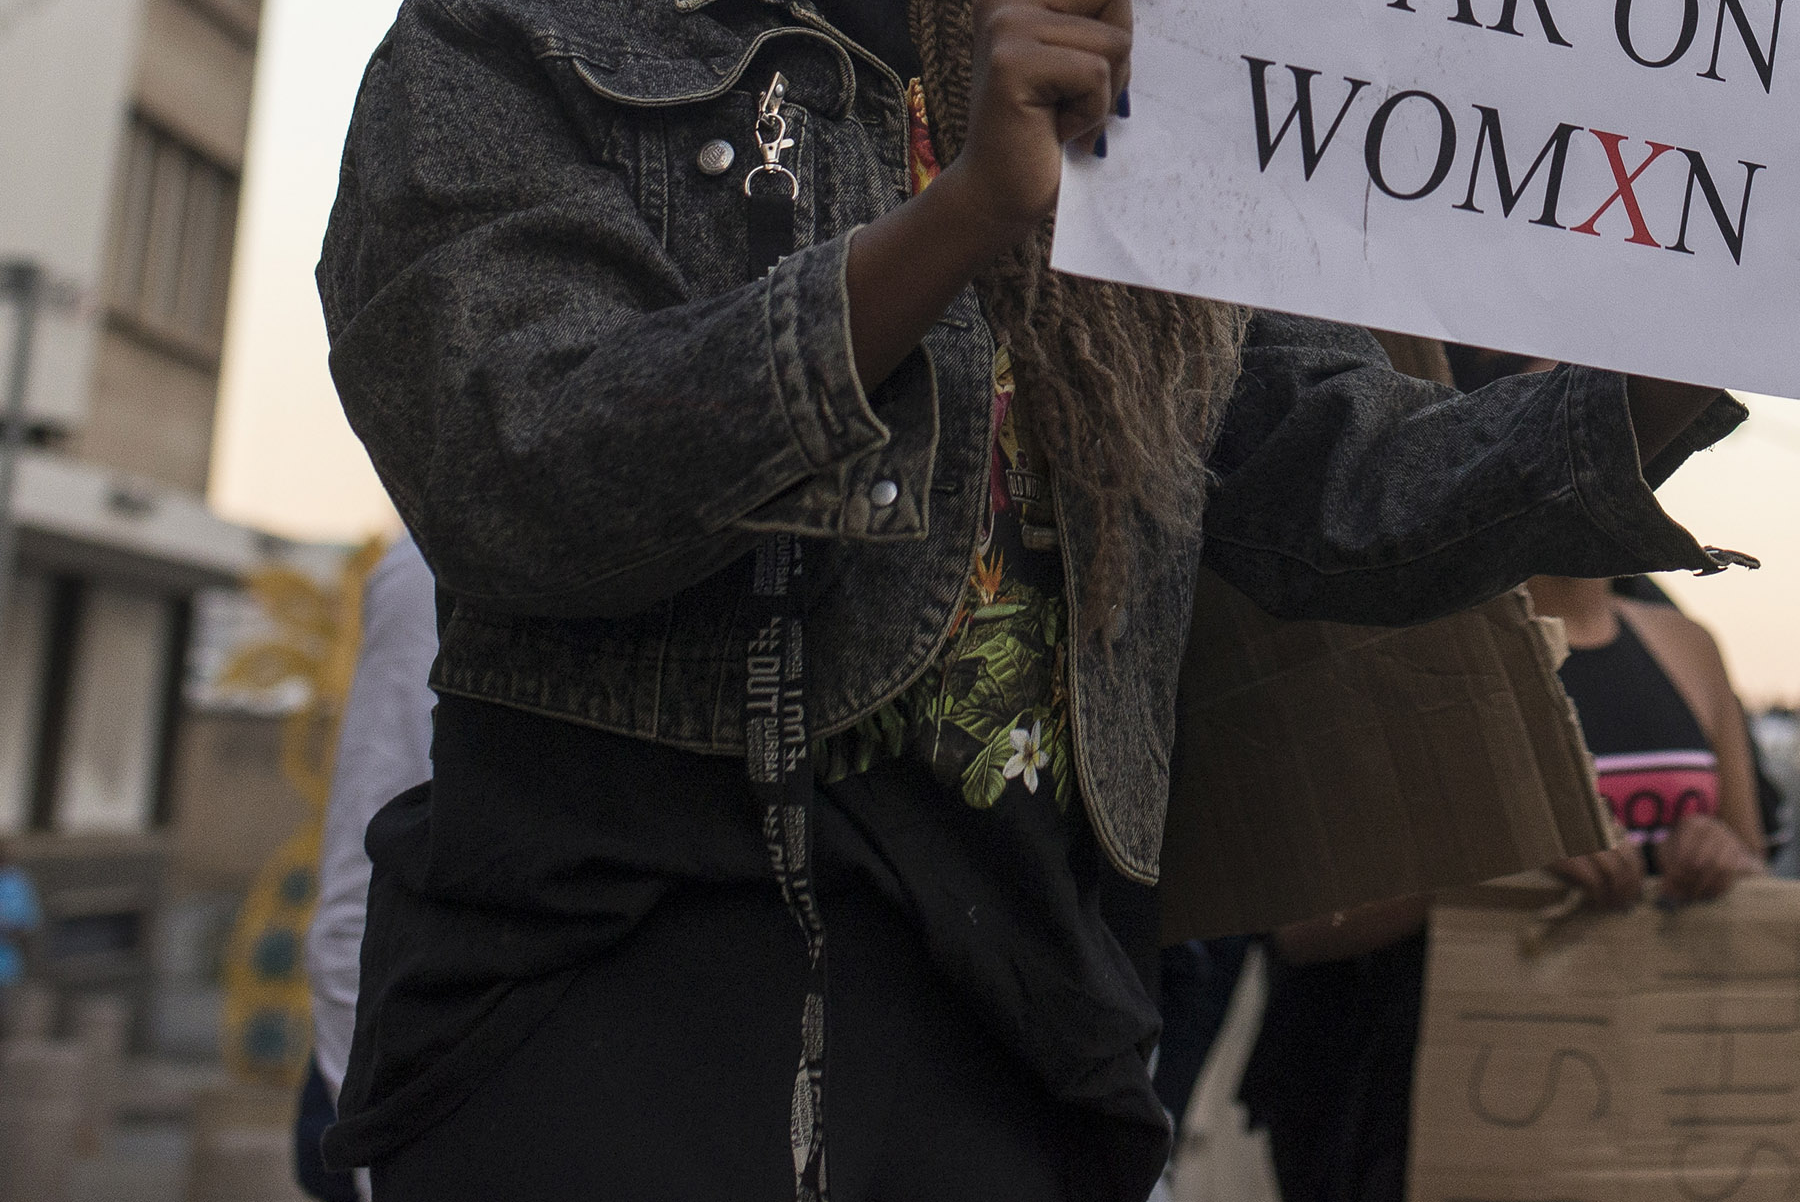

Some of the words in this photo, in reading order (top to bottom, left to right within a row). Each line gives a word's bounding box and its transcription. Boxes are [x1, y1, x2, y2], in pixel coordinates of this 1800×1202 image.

[1242, 55, 1767, 266] WOMXN
[746, 655, 782, 715] DUT
[763, 716, 779, 784] DURBAN
